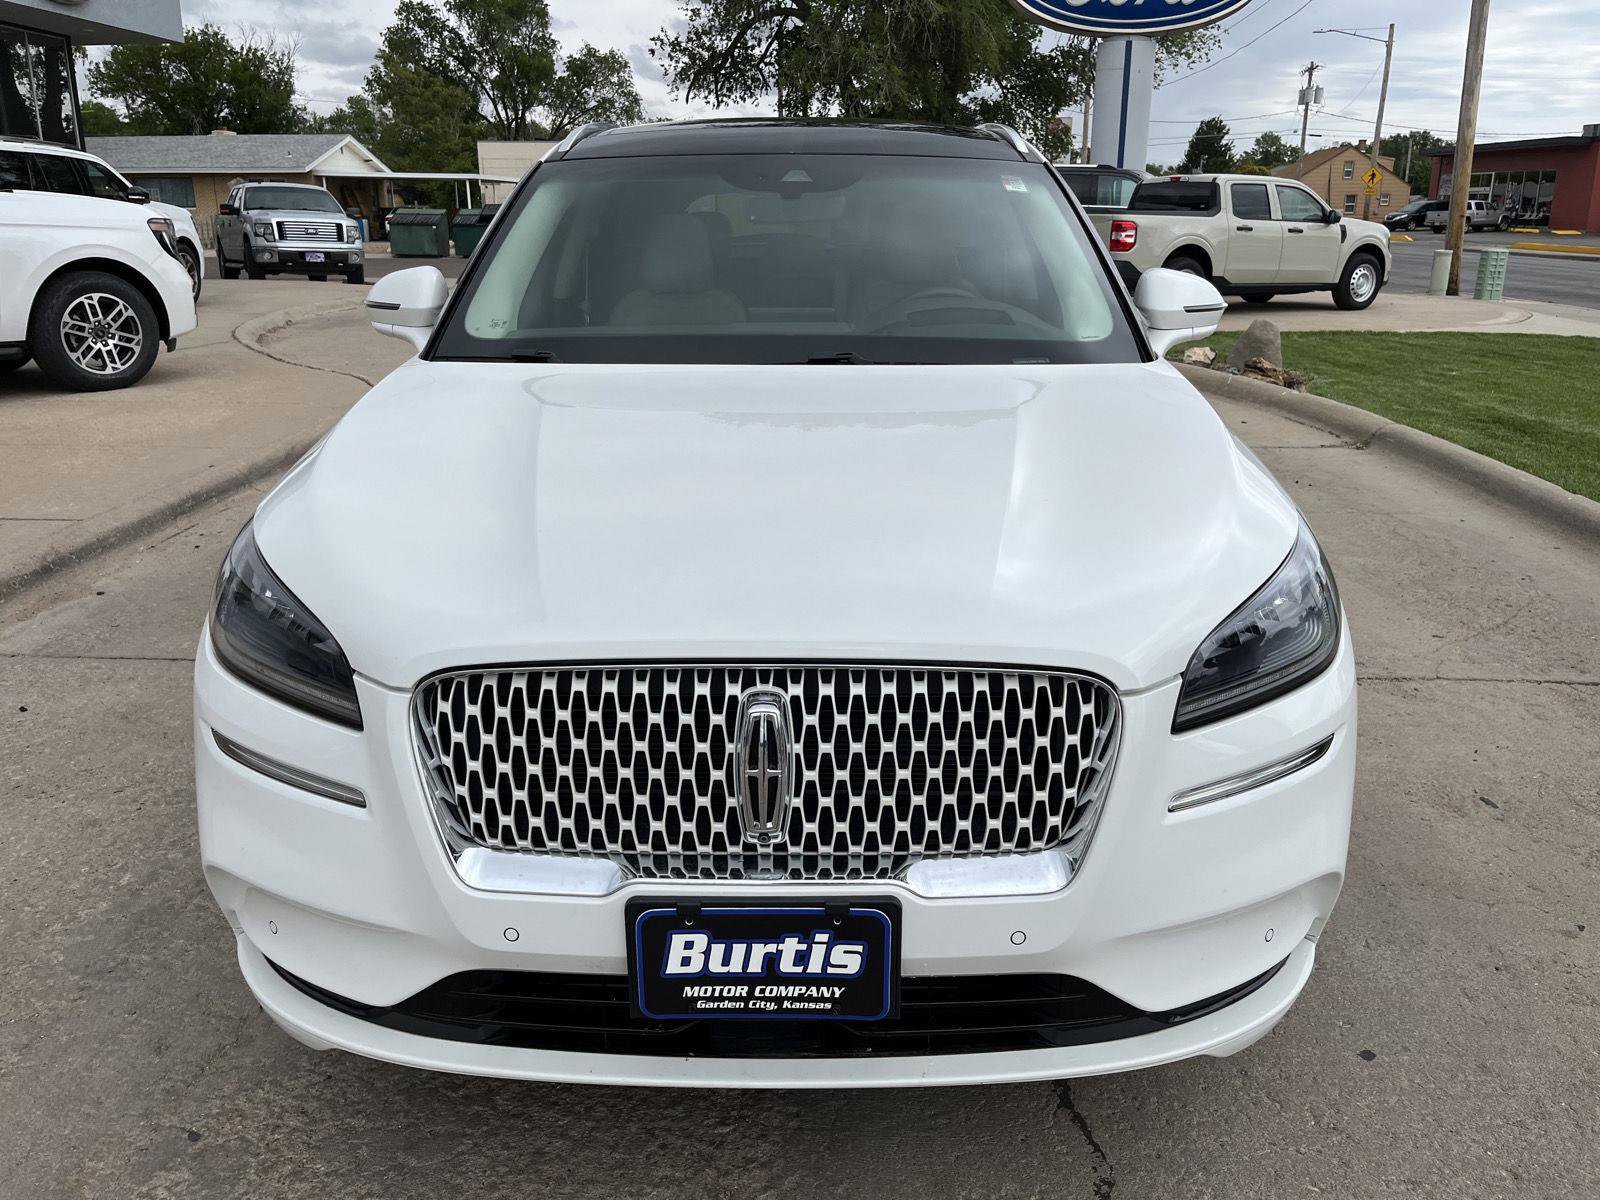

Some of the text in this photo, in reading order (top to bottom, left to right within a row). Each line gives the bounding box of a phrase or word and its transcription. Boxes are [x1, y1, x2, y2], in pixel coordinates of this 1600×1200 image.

[665, 933, 864, 975] Burtis
[682, 985, 846, 998] MOTOR COMPANY
[696, 1000, 832, 1011] Garden City, Kansas
